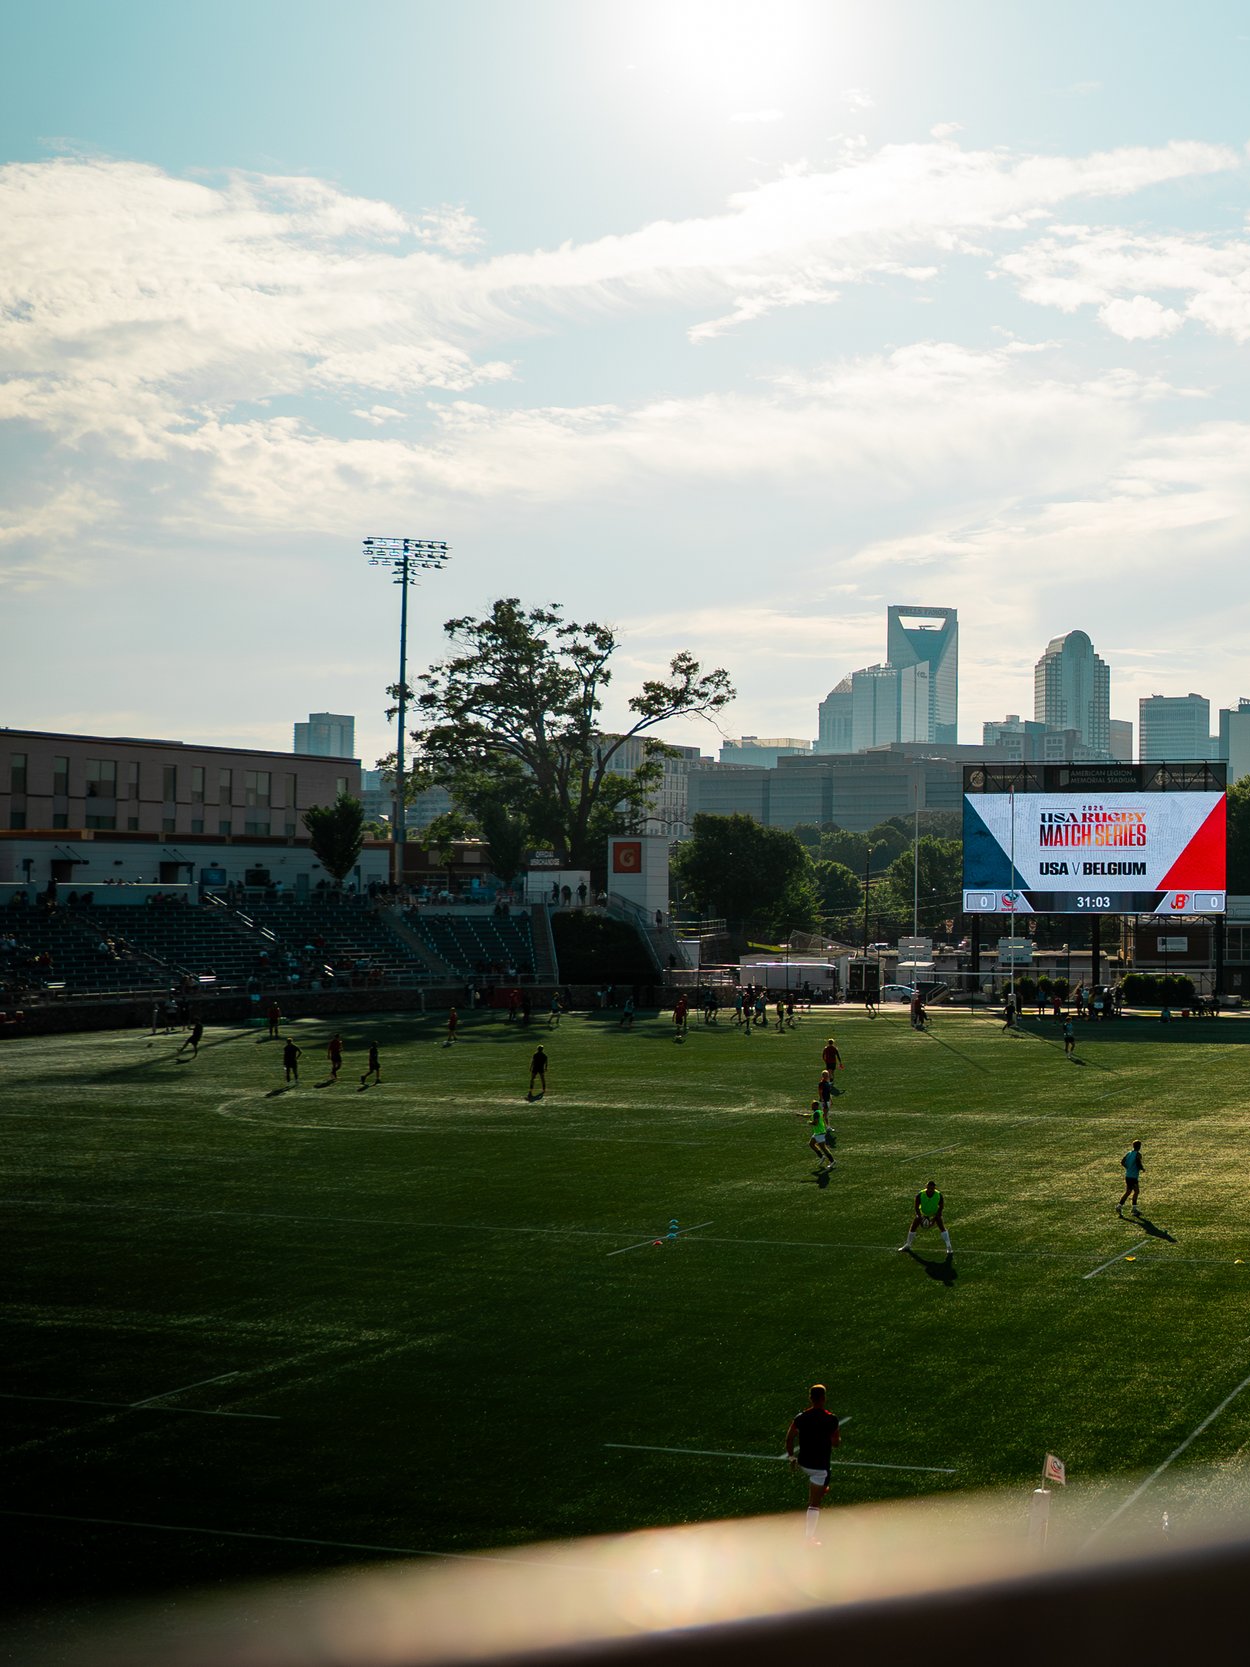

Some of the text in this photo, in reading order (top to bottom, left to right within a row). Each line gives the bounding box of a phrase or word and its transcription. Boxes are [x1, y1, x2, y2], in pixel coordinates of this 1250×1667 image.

[1040, 812, 1147, 823] USA RUGBY
[1040, 823, 1147, 846] MATCH SERIES
[1039, 862, 1147, 875] USA V BELGIUM
[980, 897, 988, 907] 0
[1076, 896, 1110, 908] 31:03
[1210, 897, 1218, 908] 0
